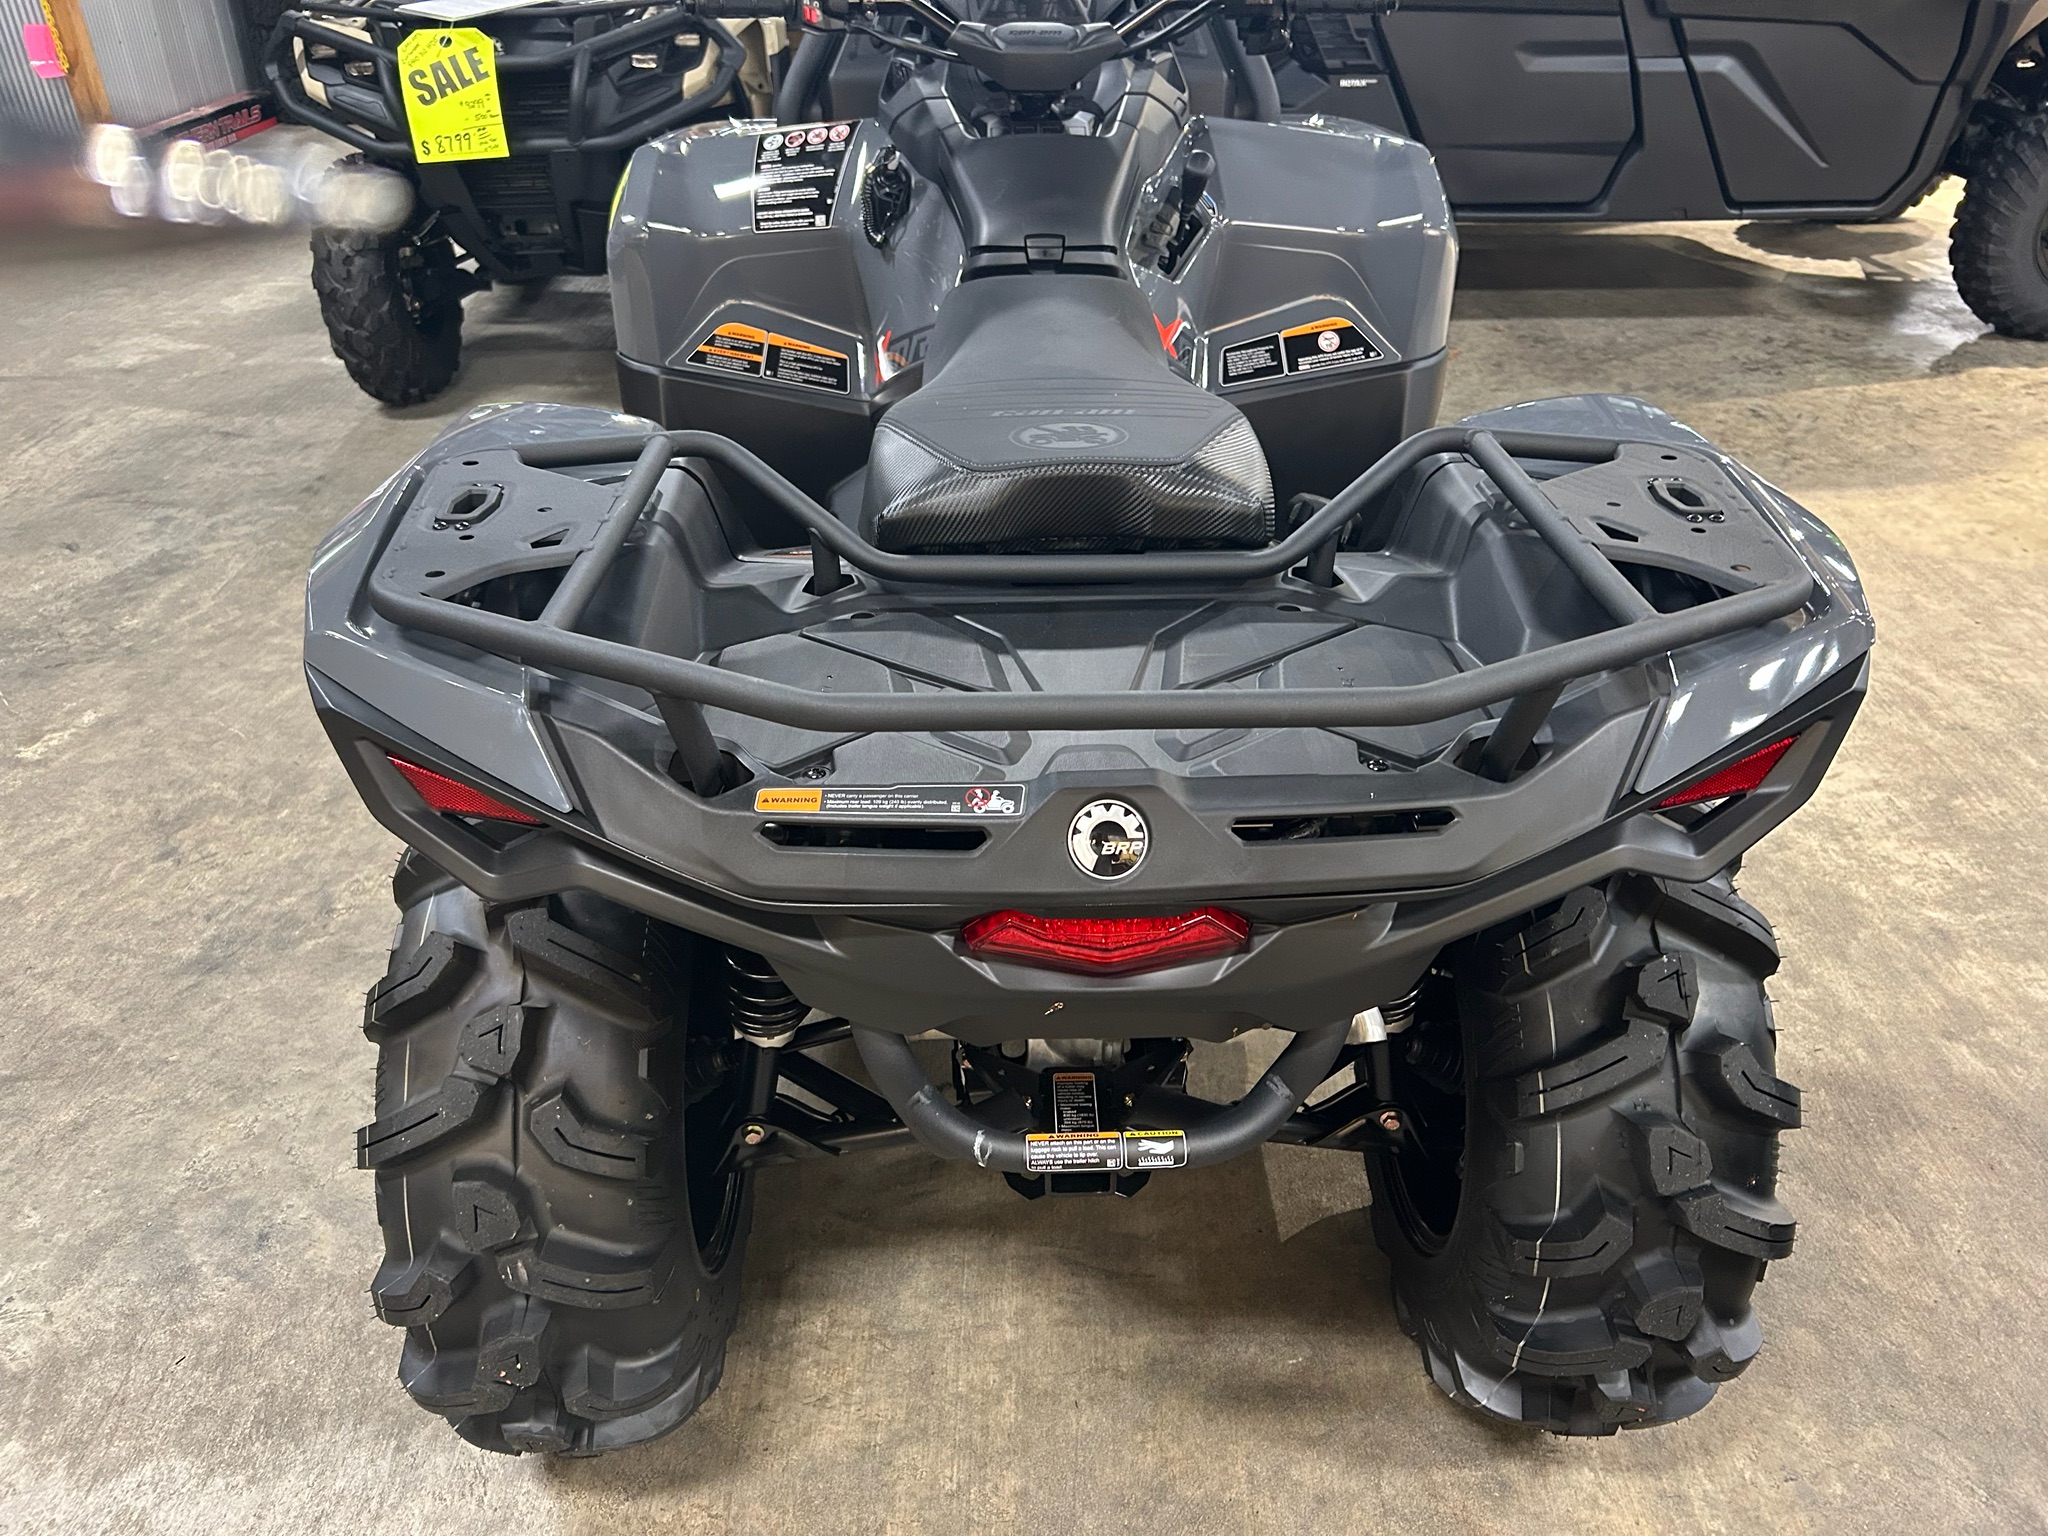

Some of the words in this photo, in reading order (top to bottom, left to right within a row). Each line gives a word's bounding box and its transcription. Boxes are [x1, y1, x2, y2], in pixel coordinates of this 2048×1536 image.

[408, 46, 490, 106] SALE
[421, 140, 431, 156] $
[434, 132, 472, 154] 8799
[1101, 840, 1144, 856] BRP
